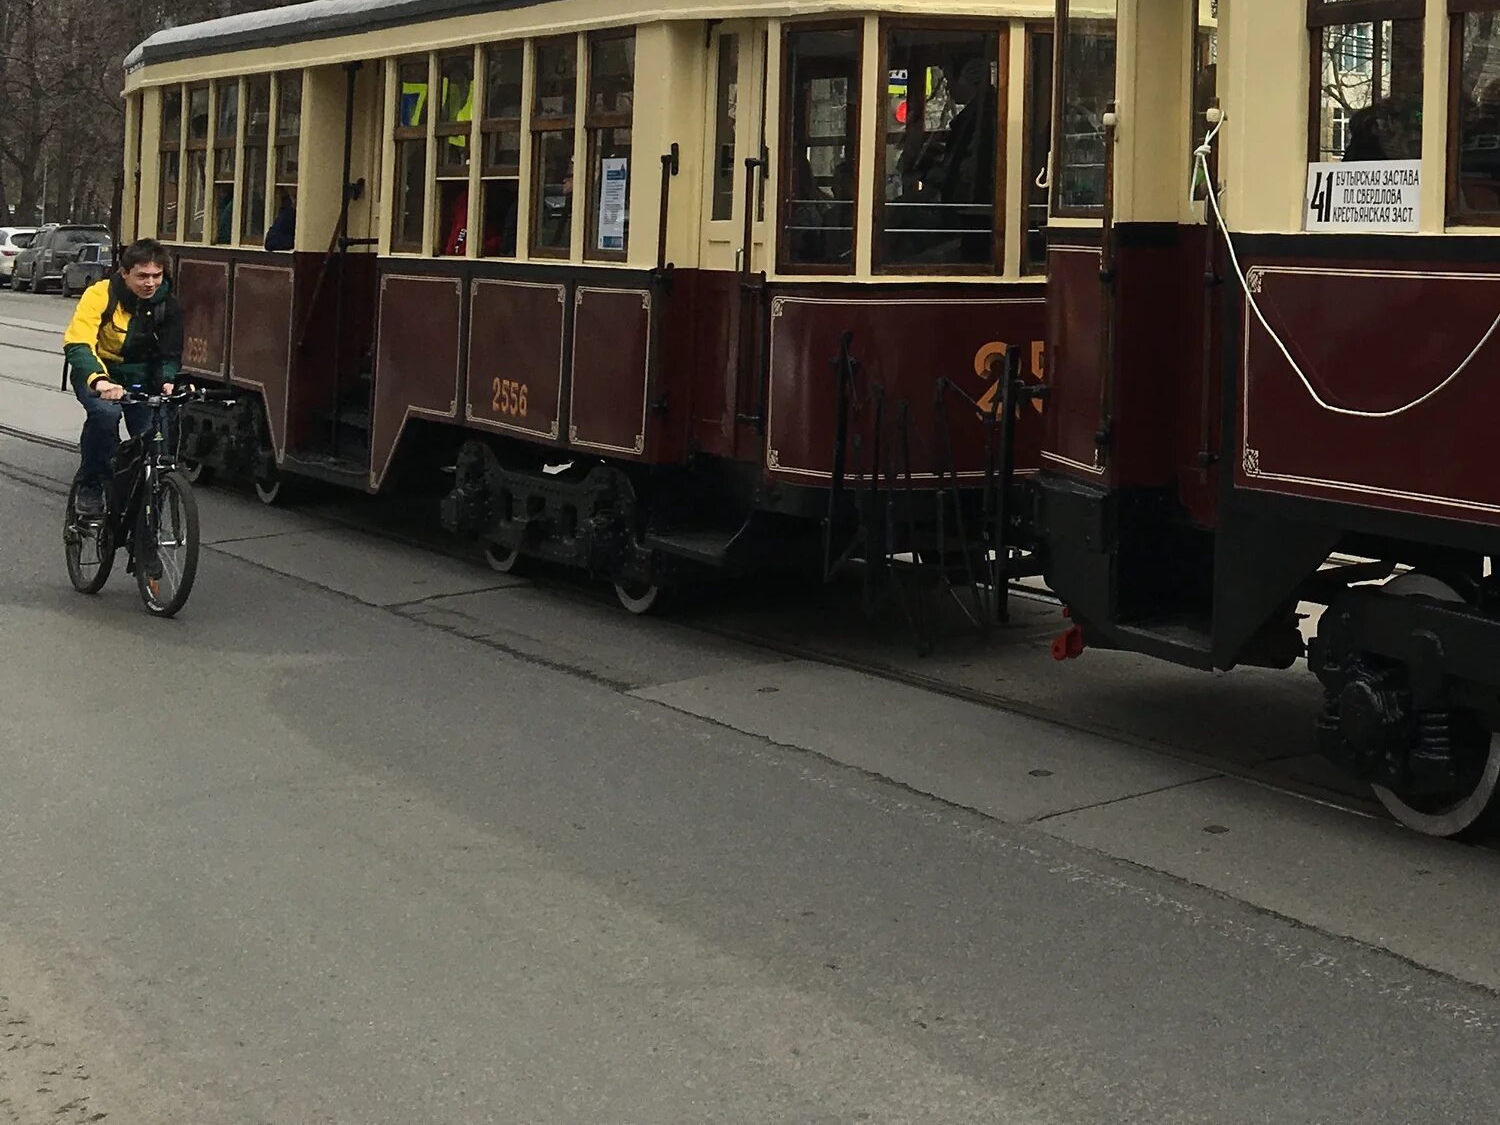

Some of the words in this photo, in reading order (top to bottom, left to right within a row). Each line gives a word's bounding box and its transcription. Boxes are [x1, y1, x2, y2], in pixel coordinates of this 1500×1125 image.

[1336, 170, 1381, 186] БУТЫРСКАЯ
[1382, 169, 1420, 186] ЗАСТАВА
[1310, 171, 1334, 223] 41
[1356, 188, 1402, 205] СВЕРДЛОВА
[1333, 206, 1391, 223] КРЕСТЬЯНСКАЯ
[1391, 206, 1414, 223] ЗАСТ.
[974, 340, 1045, 422] 2
[492, 376, 528, 416] 2556
